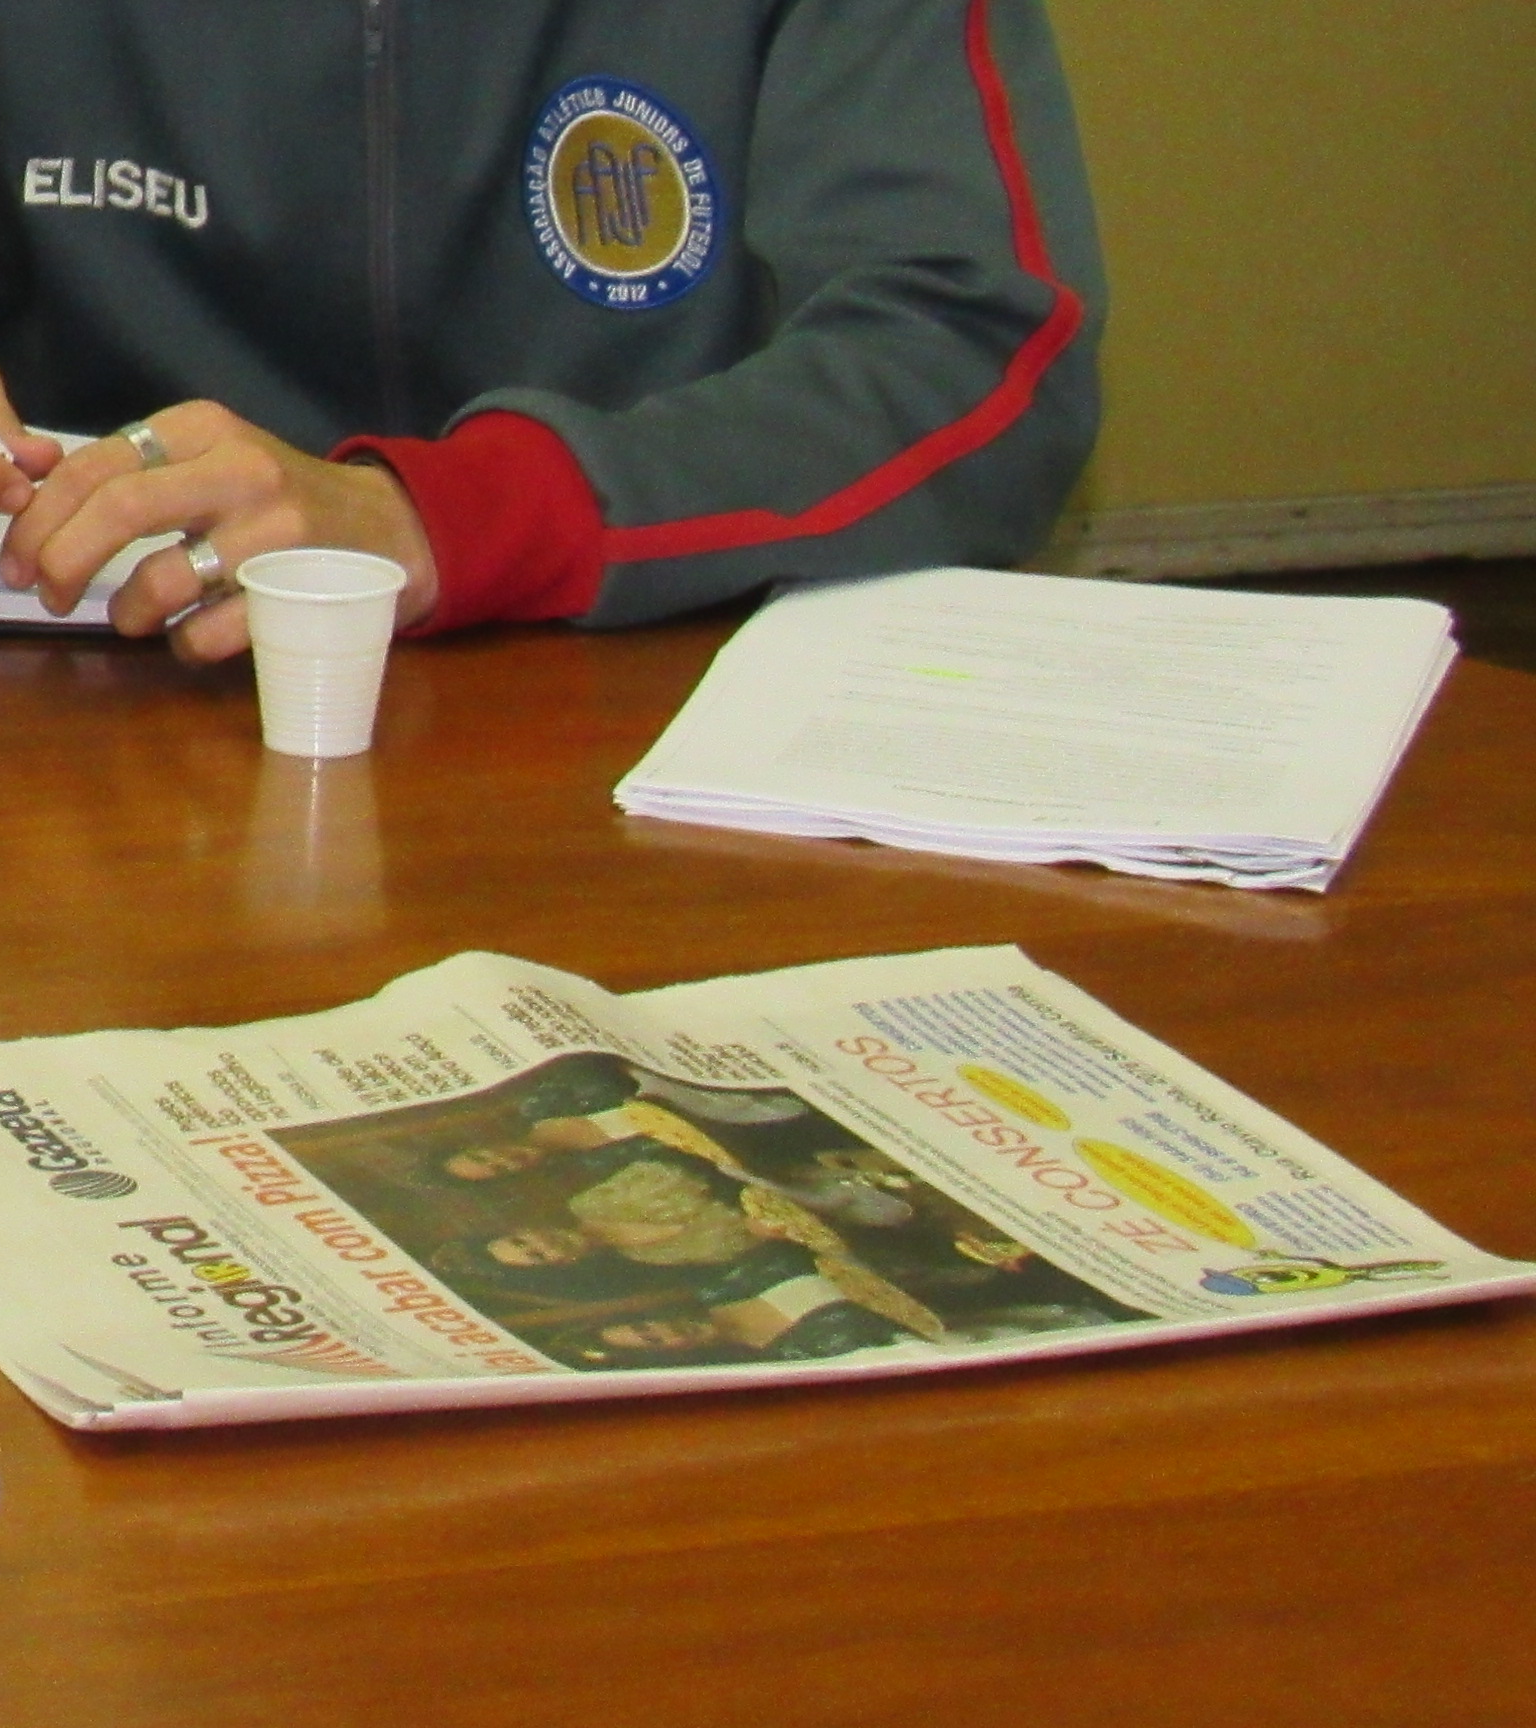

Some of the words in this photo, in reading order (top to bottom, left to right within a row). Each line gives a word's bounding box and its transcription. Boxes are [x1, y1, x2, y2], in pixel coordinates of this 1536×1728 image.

[613, 90, 689, 154] JUNIORS
[23, 157, 209, 229] ELISEU
[683, 158, 708, 185] DE
[672, 192, 712, 277] FUTEBOL
[606, 283, 648, 301] 2012
[834, 1036, 1123, 1212] CONSERTOS
[188, 1133, 321, 1207] Pizza!
[1268, 1158, 1316, 1180] Rua
[294, 1208, 388, 1261] com
[1100, 1217, 1199, 1255] ZÉ
[360, 1270, 497, 1345] acabar
